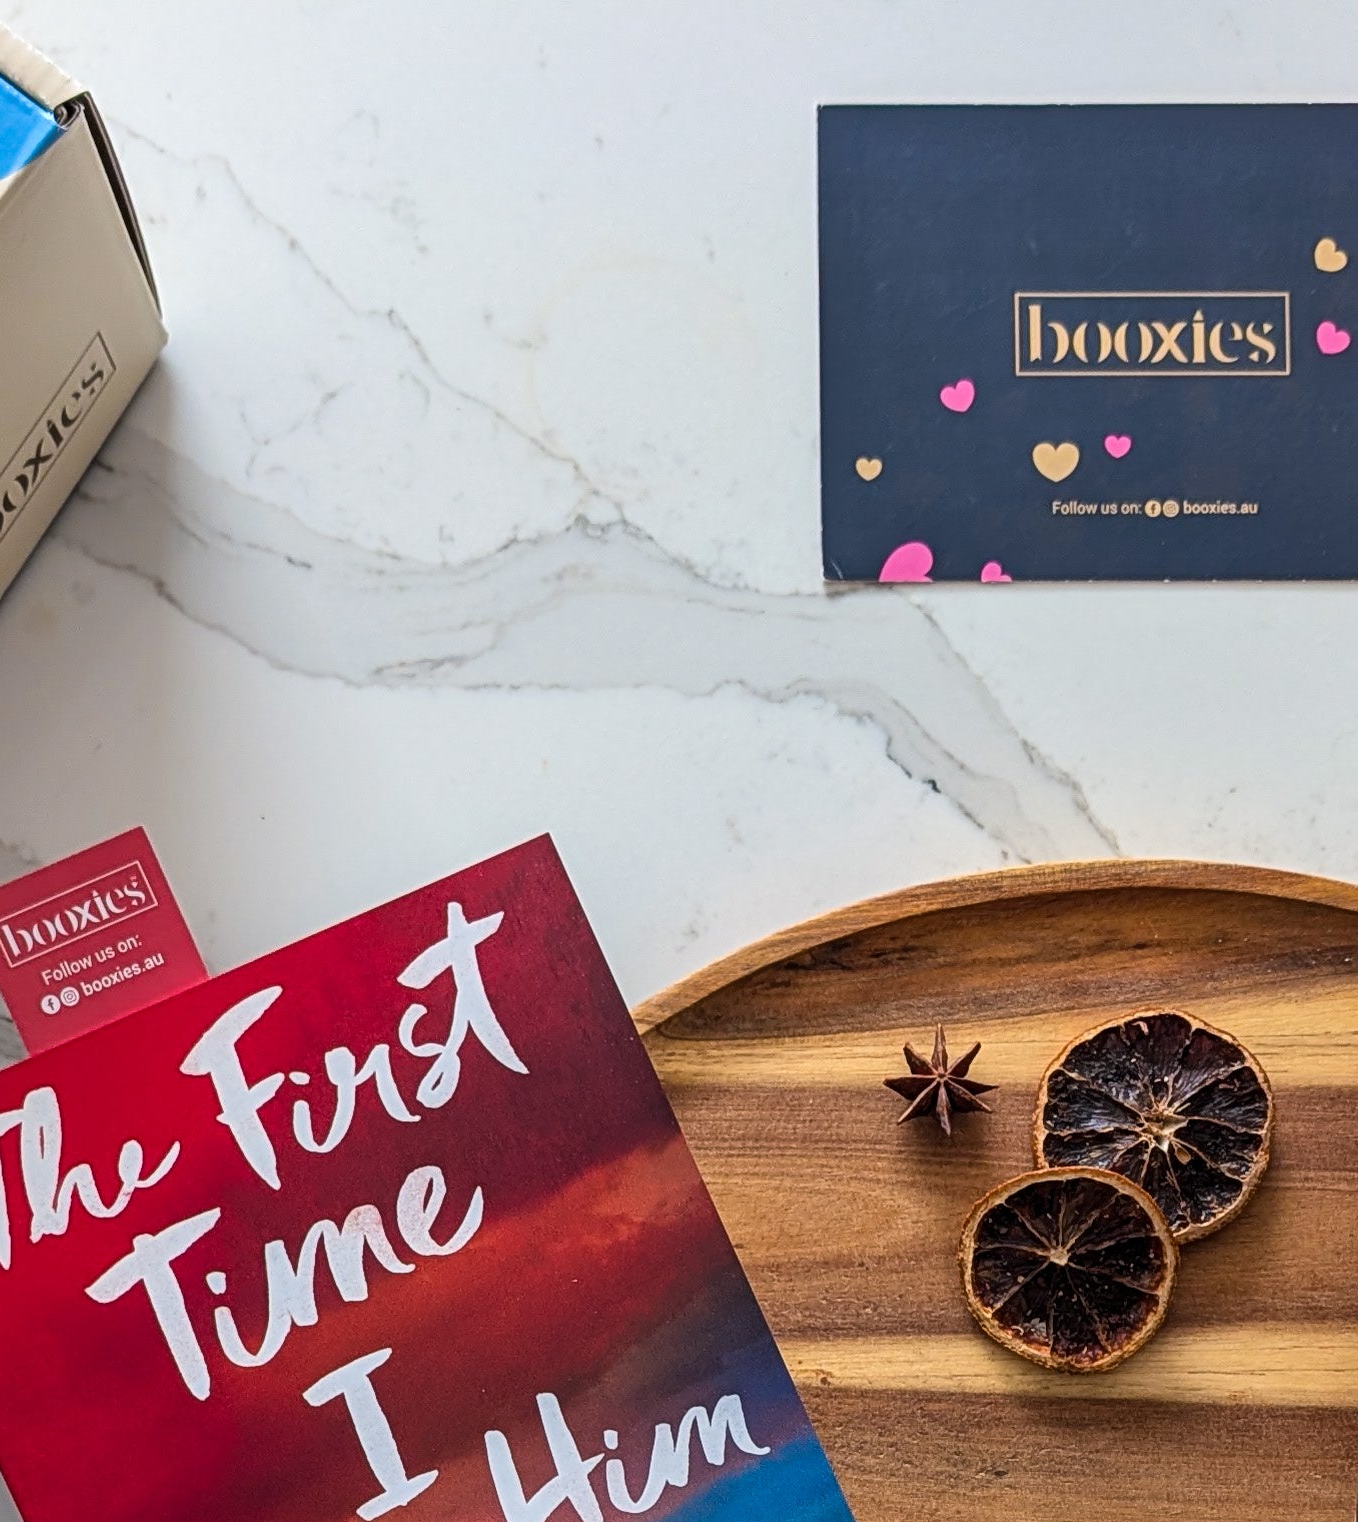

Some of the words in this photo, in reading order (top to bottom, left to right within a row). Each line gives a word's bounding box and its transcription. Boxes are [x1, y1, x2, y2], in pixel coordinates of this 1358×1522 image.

[1028, 305, 1276, 365] booxies
[1052, 501, 1097, 515] Follow
[1101, 503, 1117, 515] us
[1121, 503, 1142, 515] on:
[1183, 501, 1258, 515] booxies.au
[2, 880, 146, 956] booxies
[42, 954, 92, 985] Follow
[95, 943, 115, 964] us
[118, 934, 143, 954] on:
[80, 952, 165, 997] booxies.au
[179, 901, 529, 1190] First
[85, 1164, 484, 1400] Time
[303, 1348, 439, 1522] I
